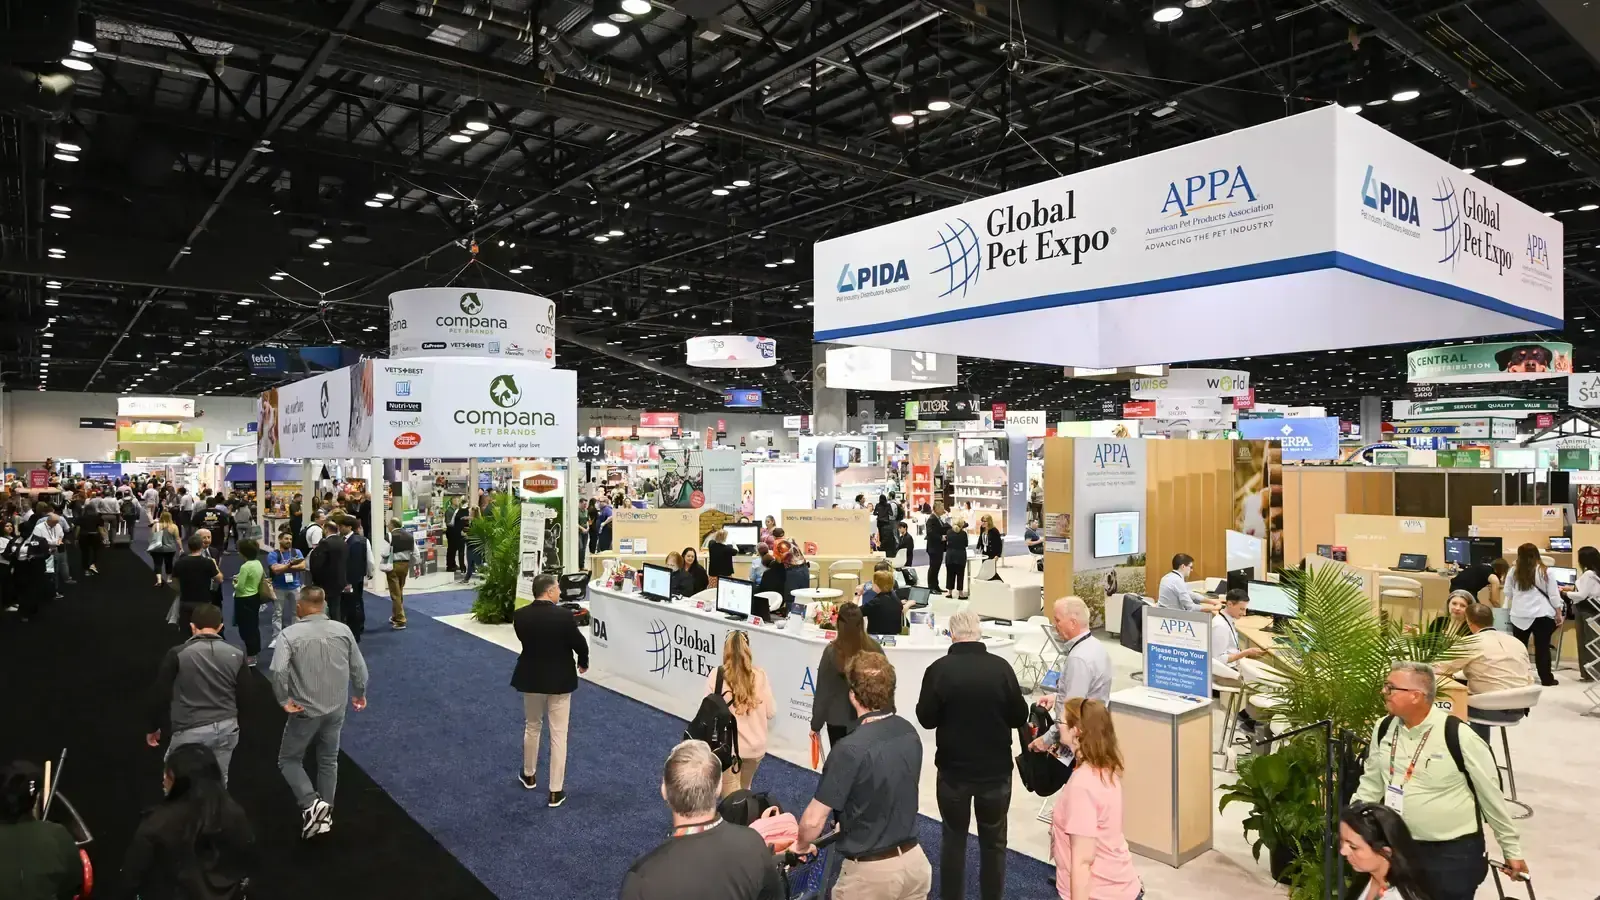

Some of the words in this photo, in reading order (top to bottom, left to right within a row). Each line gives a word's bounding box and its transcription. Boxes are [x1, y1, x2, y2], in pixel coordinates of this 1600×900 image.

[1161, 164, 1258, 217] APPA
[986, 190, 1076, 237] Global
[1380, 182, 1420, 227] PIDA
[1464, 188, 1500, 231] Global
[1145, 222, 1178, 236] American
[1179, 220, 1191, 228] Pet
[1193, 212, 1226, 226] Products
[1228, 202, 1274, 218] Association
[1145, 236, 1192, 251] ADVANCING
[1194, 232, 1209, 242] THE
[1212, 230, 1226, 238] PET
[1230, 220, 1274, 235] INDUSTRY
[1464, 222, 1482, 258] Pet
[986, 241, 1028, 271] Pet
[1526, 233, 1549, 270] APPA
[858, 259, 910, 290] PIDA
[436, 316, 508, 328] compana
[252, 354, 275, 363] fetch
[1417, 354, 1467, 366] CENTRAL
[1429, 363, 1491, 372] DISTRIBUTION
[454, 410, 556, 427] compana
[1006, 416, 1038, 424] HAGEN
[311, 421, 340, 441] compana
[1263, 437, 1313, 447] ERPA
[1410, 437, 1432, 446] LIFE
[1093, 444, 1130, 468] APPA
[674, 624, 716, 655] Global
[1160, 619, 1196, 638] APPA
[674, 648, 693, 672] Pet
[697, 654, 714, 678] Ex
[1151, 646, 1172, 655] Please
[1173, 649, 1188, 657] Drop
[1190, 651, 1204, 659] Your
[1159, 654, 1178, 662] Forms
[1180, 657, 1196, 665] Here:
[800, 666, 817, 696] A
[790, 712, 811, 722] ADVANC
